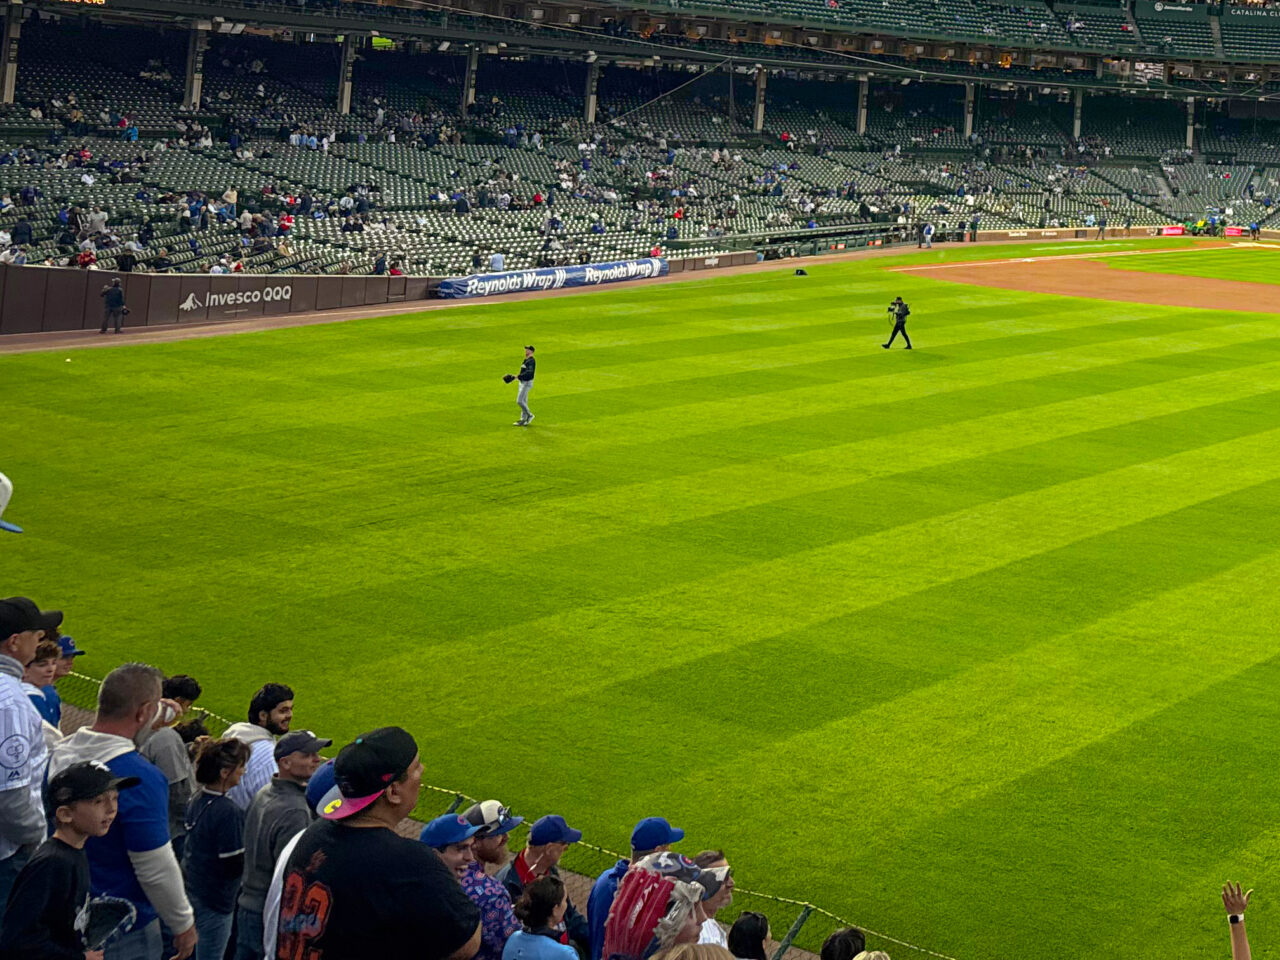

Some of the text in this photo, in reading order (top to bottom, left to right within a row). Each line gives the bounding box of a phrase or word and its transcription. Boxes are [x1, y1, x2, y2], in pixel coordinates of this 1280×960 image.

[467, 272, 552, 296] Reynolds Wrap
[585, 262, 652, 284] Reynolds Wrap
[205, 285, 291, 307] Invesco QQQ
